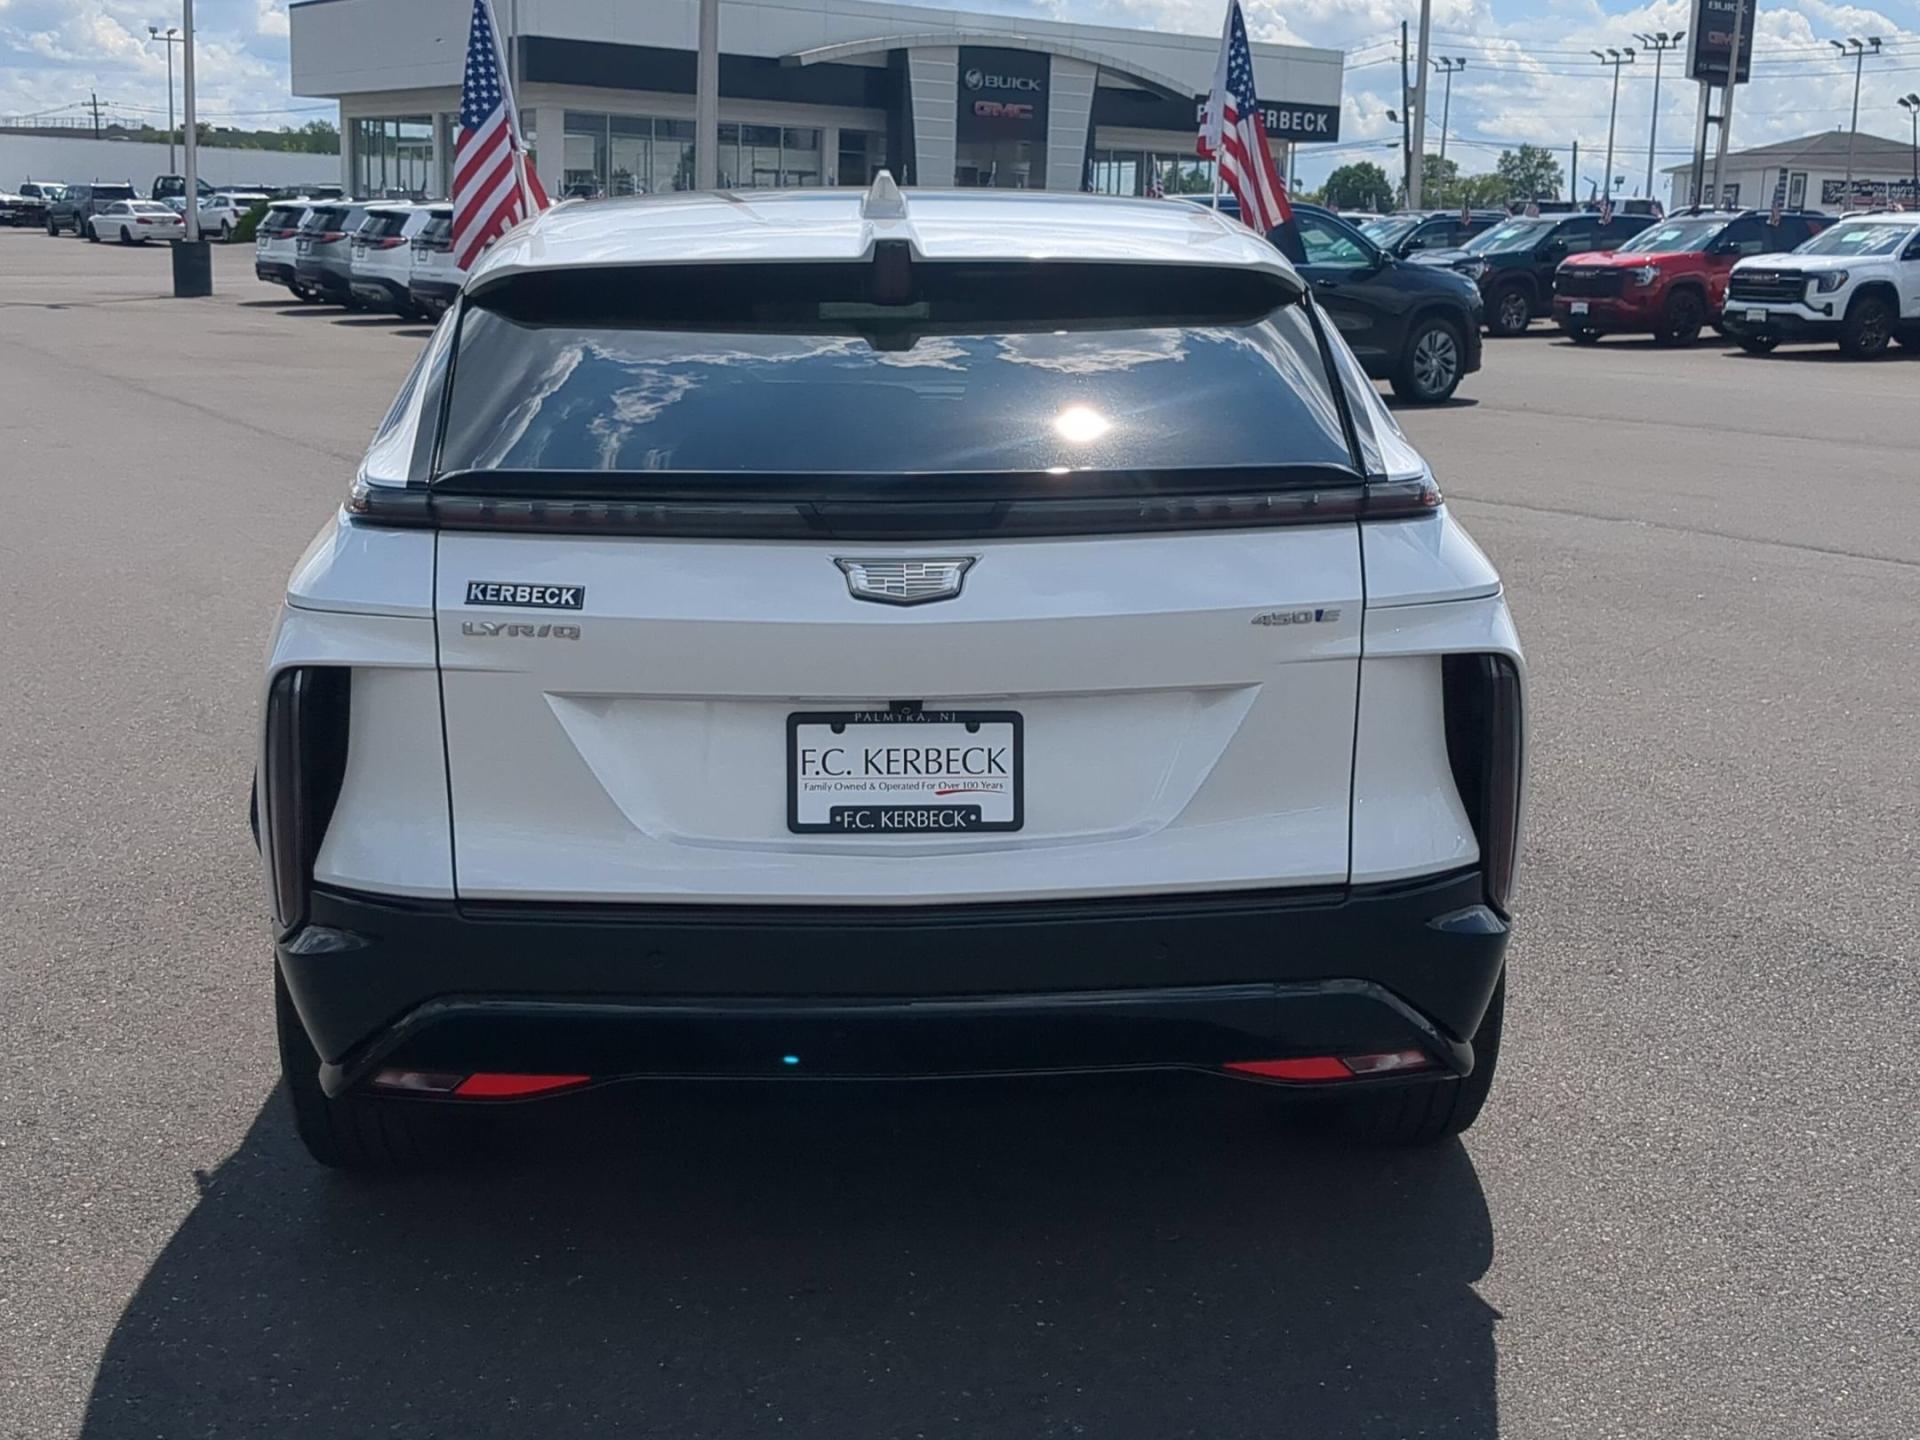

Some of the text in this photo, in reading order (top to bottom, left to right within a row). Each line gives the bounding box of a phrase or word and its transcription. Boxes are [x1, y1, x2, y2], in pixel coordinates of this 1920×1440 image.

[984, 75, 1041, 91] BUICK
[975, 101, 1033, 119] GMC
[469, 584, 577, 605] KERBECK
[462, 621, 581, 641] LYRIQ
[802, 746, 1007, 776] F.C. KERBECK
[804, 782, 832, 792] Family
[834, 781, 867, 791] Owned
[878, 781, 920, 792] Operated
[922, 781, 936, 790] For
[938, 781, 960, 790] Over
[962, 781, 979, 790] 100
[980, 780, 1003, 790] Years
[844, 810, 967, 828] F.C. KERBECK
